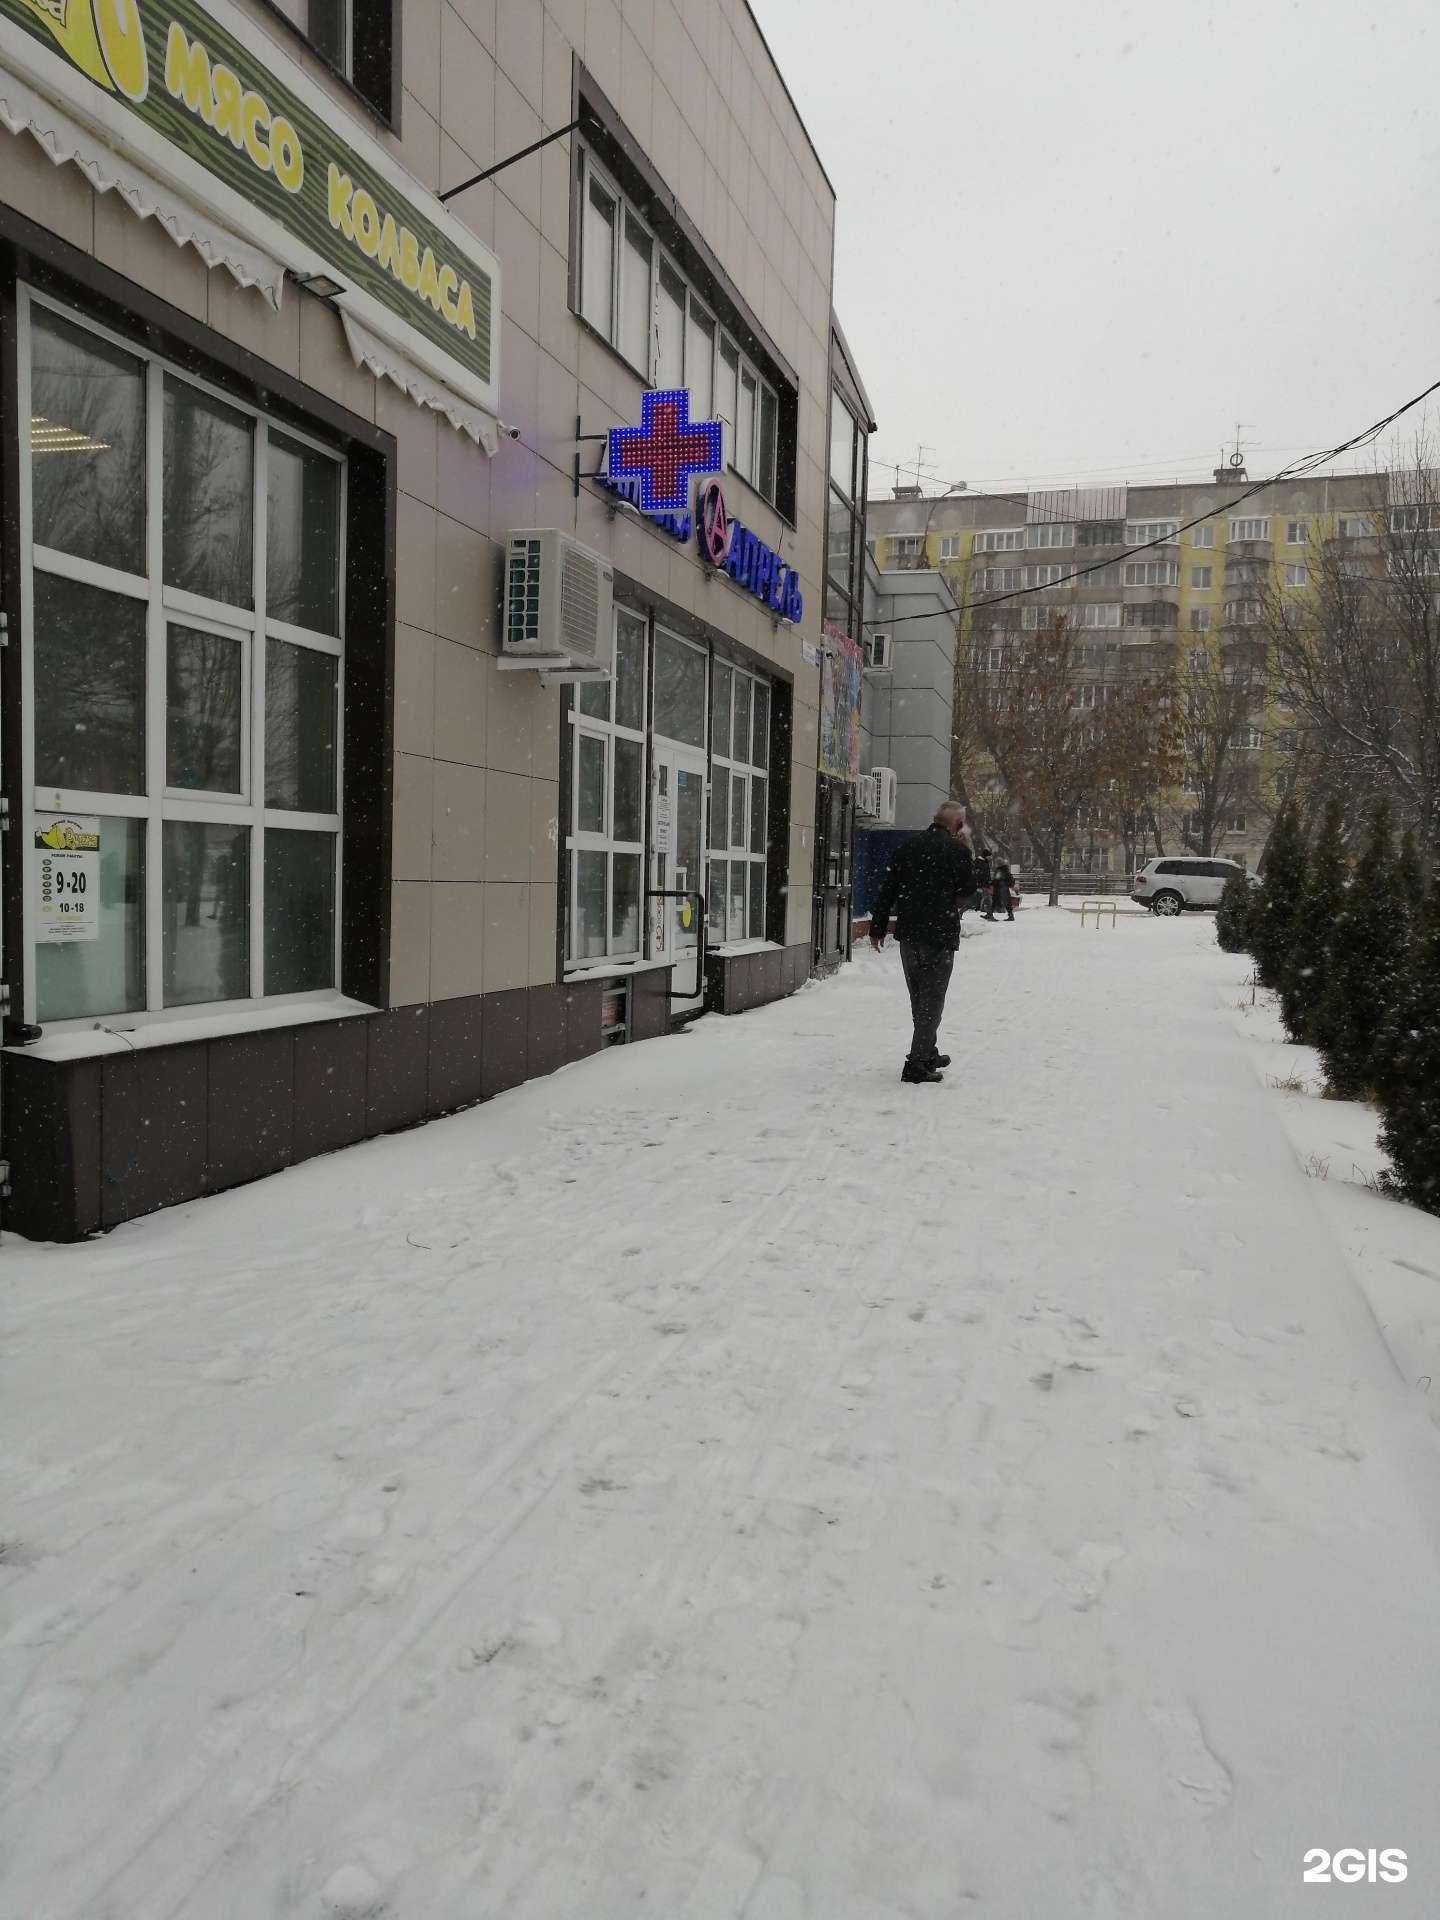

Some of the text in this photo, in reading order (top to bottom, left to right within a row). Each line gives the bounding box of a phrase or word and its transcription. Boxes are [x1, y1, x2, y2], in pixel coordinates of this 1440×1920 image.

[165, 21, 304, 193] МЯСО
[327, 162, 476, 341] КОЛБАСА
[56, 871, 86, 893] 9-20
[60, 902, 84, 913] 10-18
